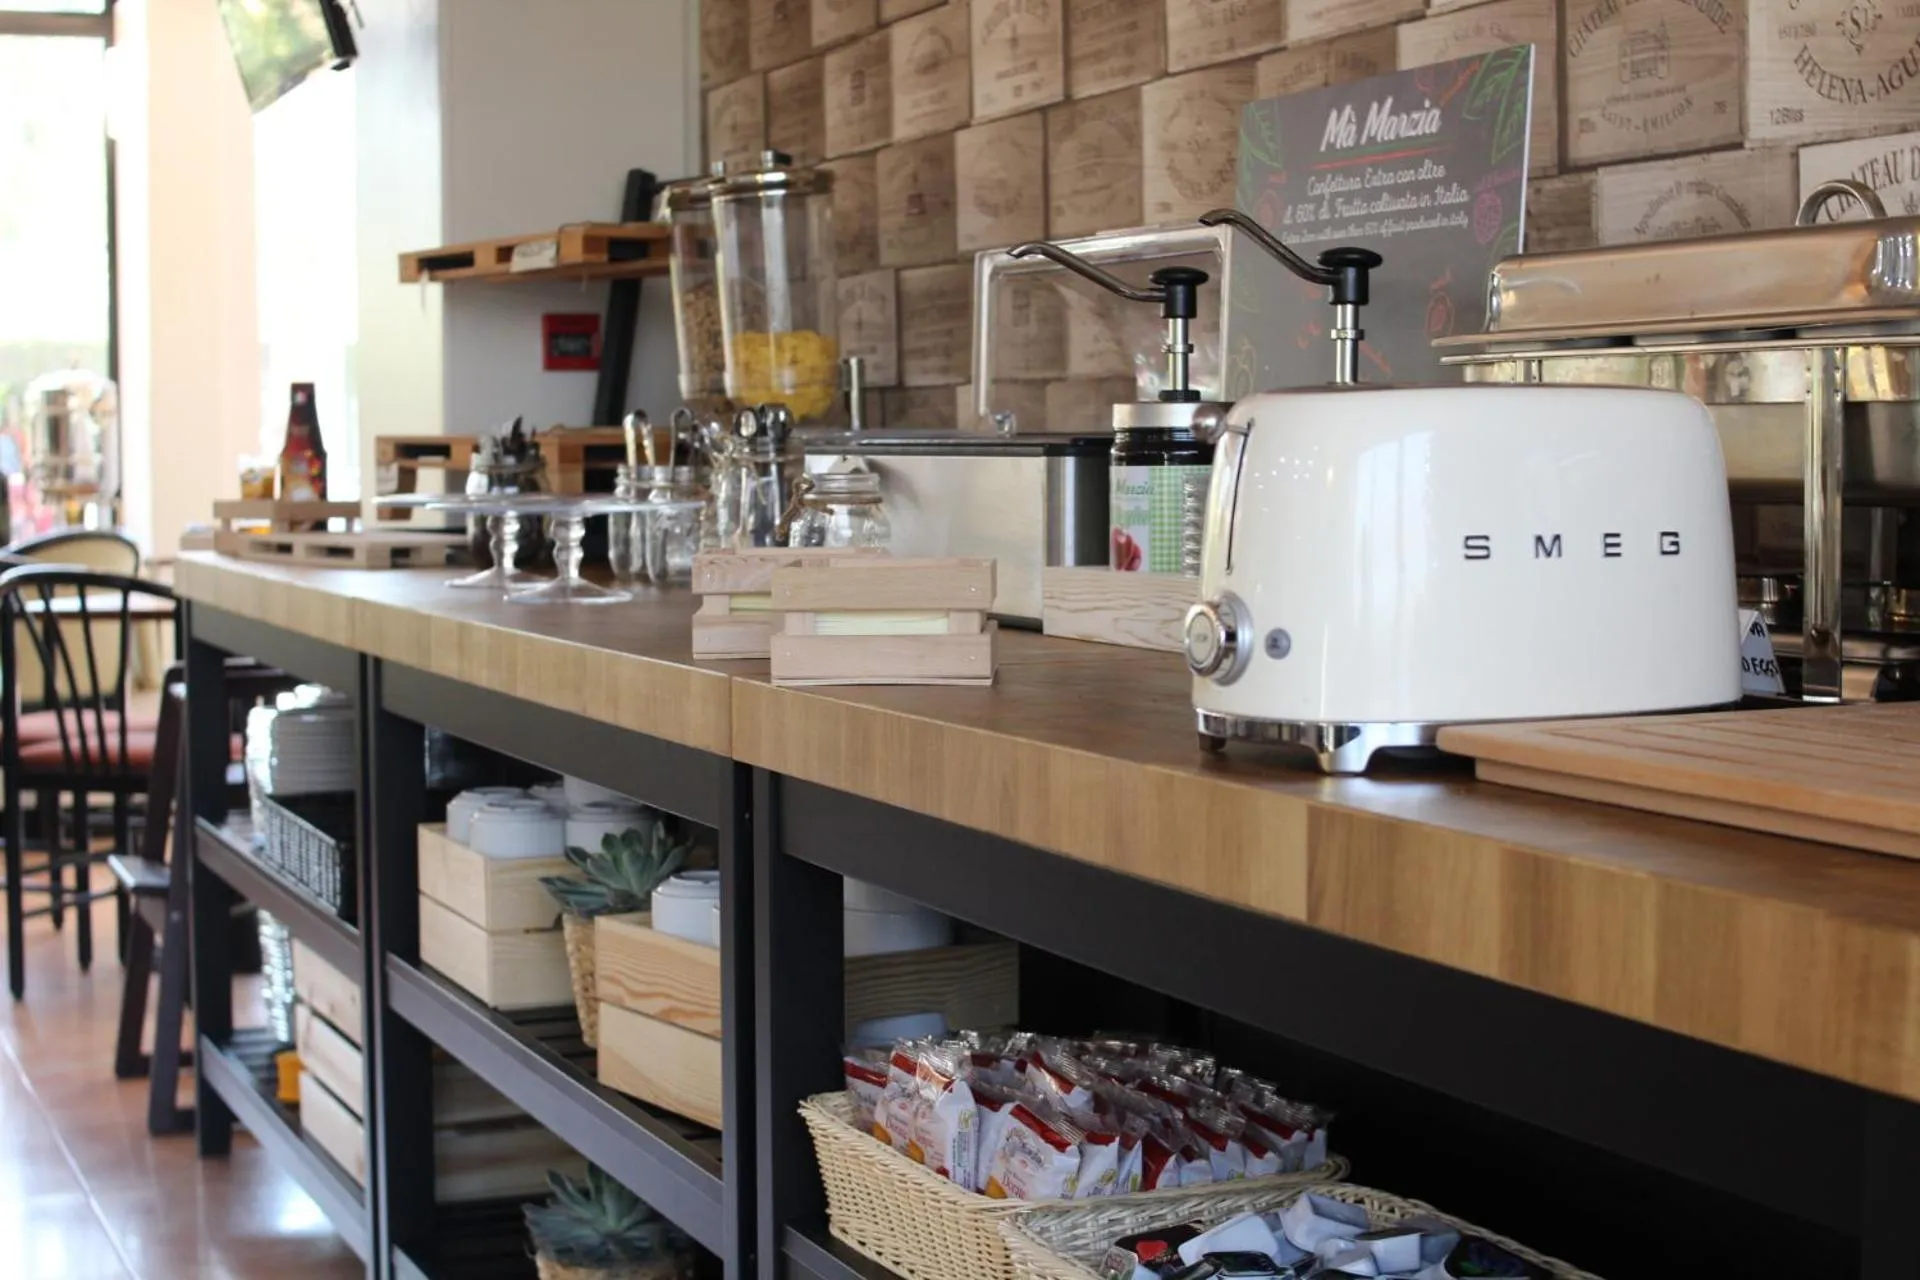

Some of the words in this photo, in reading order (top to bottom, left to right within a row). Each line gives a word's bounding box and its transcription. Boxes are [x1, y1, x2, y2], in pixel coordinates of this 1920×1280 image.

[1320, 104, 1357, 151] Mà
[1360, 96, 1442, 145] Marzia
[1307, 173, 1362, 199] Confettura
[1364, 167, 1394, 188] Extra
[1396, 169, 1415, 183] con
[1417, 159, 1446, 180] oltre
[1419, 195, 1431, 207] in
[1434, 182, 1468, 206] Italia
[1463, 531, 1681, 560] SMEG
